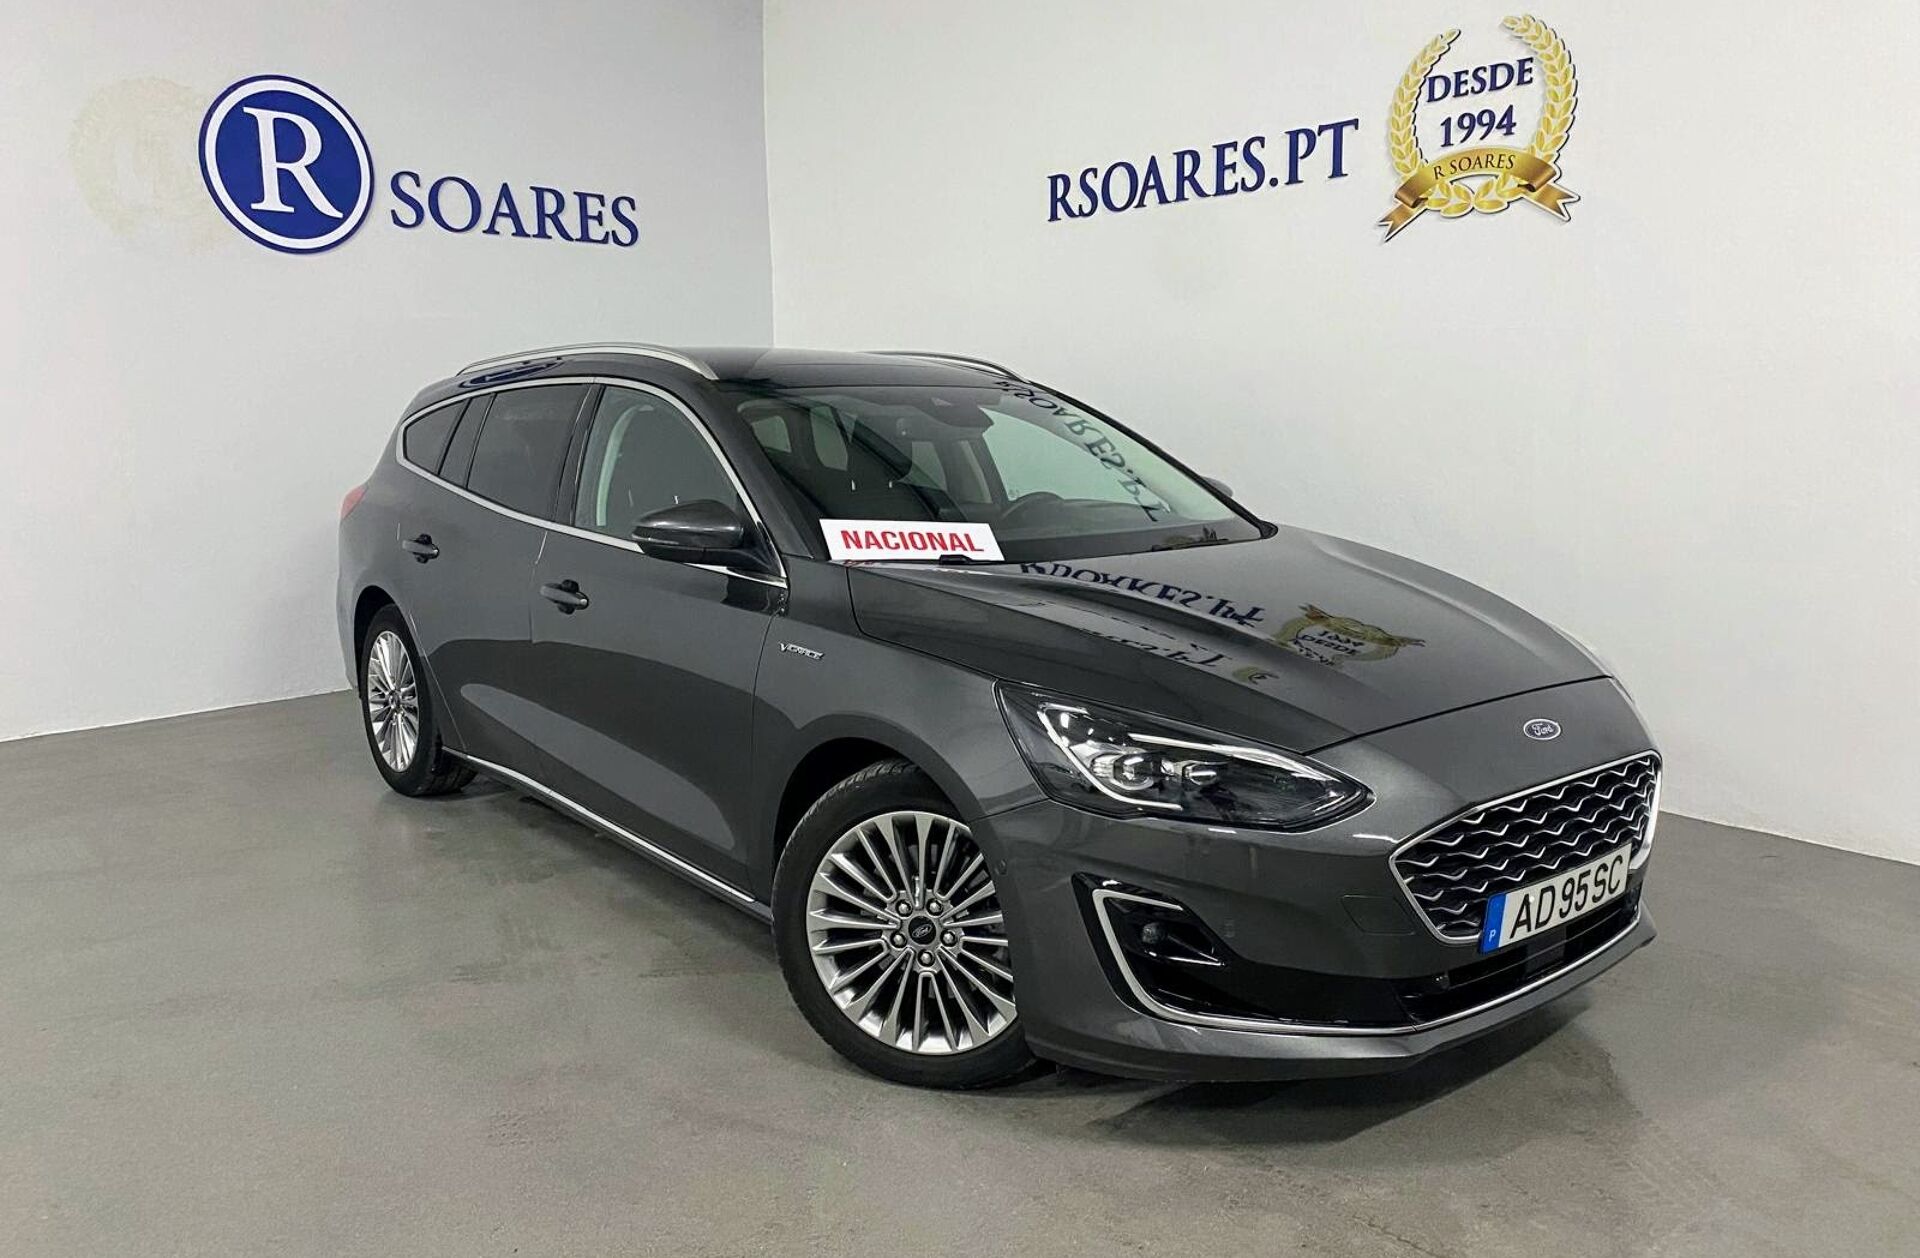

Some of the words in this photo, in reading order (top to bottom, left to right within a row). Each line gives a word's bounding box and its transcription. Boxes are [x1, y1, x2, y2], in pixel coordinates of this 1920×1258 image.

[1426, 57, 1534, 102] DESDE
[1440, 104, 1517, 147] 1994
[243, 106, 343, 218] R
[390, 170, 639, 247] SOARES
[1047, 118, 1359, 222] RSOARES.PT
[1433, 165, 1445, 180] R
[1449, 153, 1516, 175] SOARES
[840, 530, 984, 552] NACIONAL
[1488, 928, 1497, 942] P
